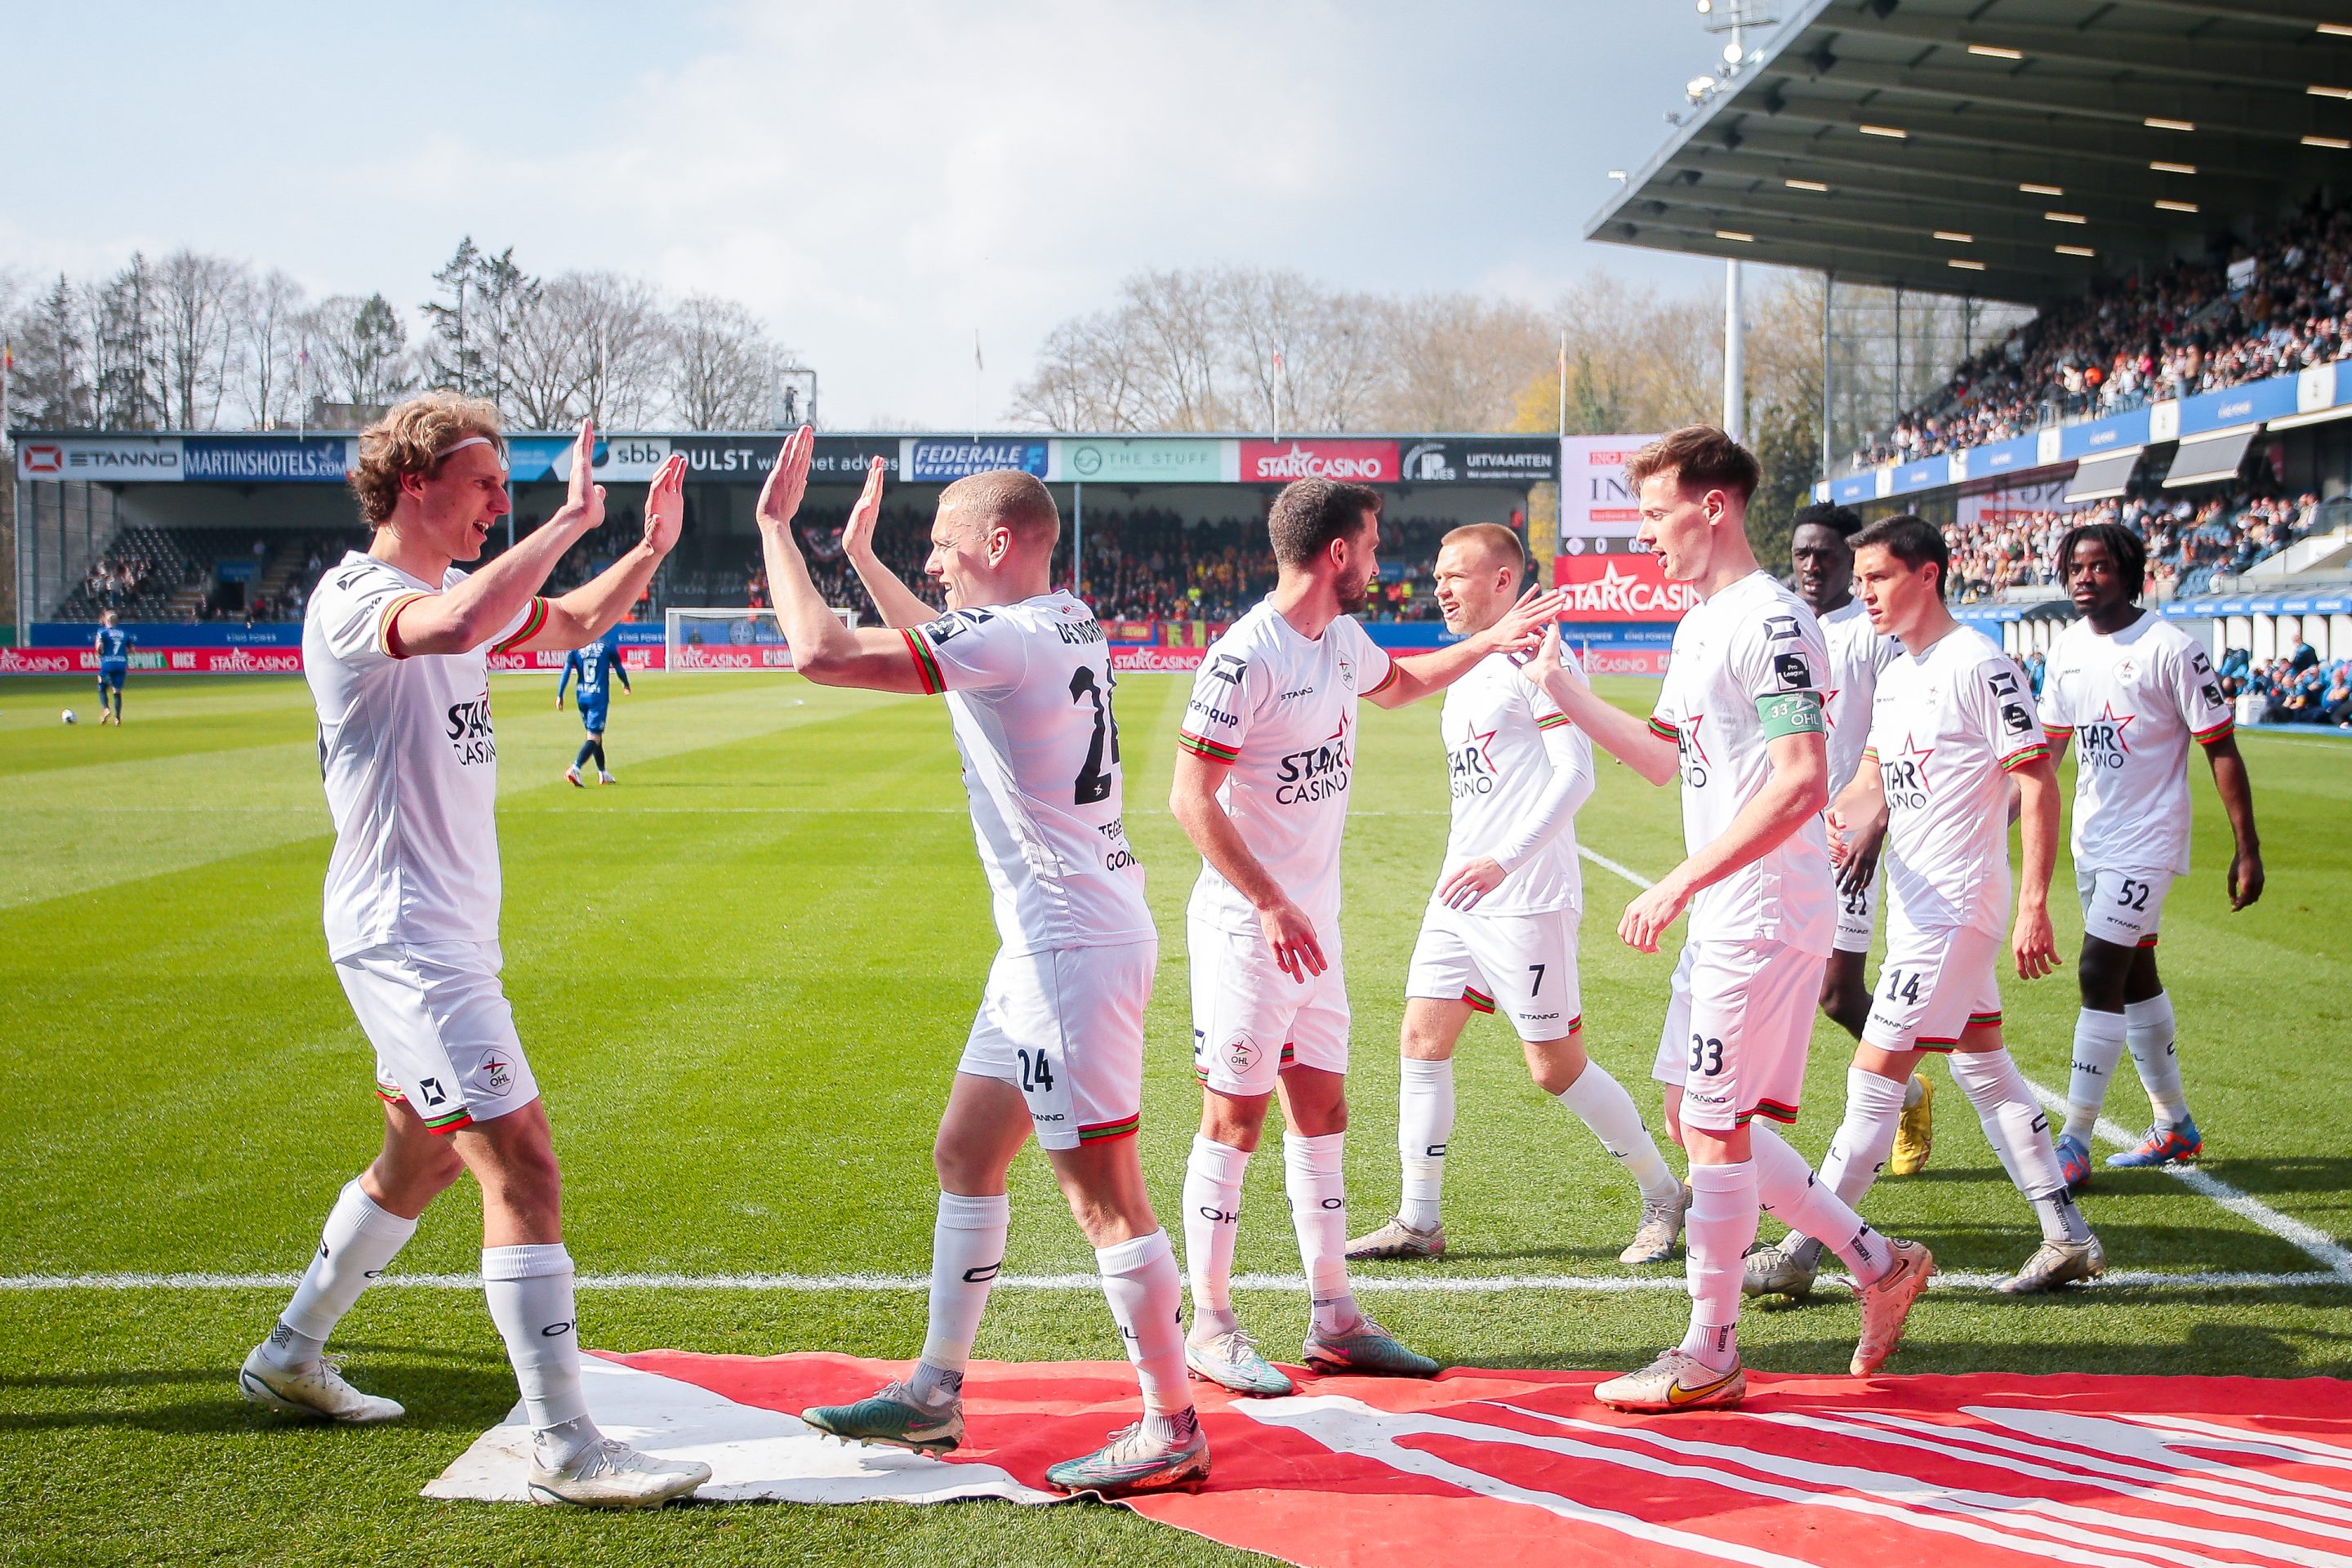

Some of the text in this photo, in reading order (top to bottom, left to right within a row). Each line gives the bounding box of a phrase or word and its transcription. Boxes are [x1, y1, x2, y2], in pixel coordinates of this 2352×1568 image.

[69, 450, 178, 468] STANNO
[617, 443, 661, 464] sbb
[840, 455, 899, 471] adves
[915, 444, 1022, 464] FEDERALE
[1109, 452, 1209, 465] THE STUFF
[1256, 449, 1382, 479] STARCASINO
[1466, 453, 1552, 467] UITVAARTEN
[1590, 478, 1630, 501] IN
[1558, 570, 1703, 615] STARCASIN
[641, 633, 665, 643] POWE
[1054, 621, 1080, 644] DE
[1071, 617, 1105, 644] NORR
[209, 652, 299, 672] STARCASINO
[537, 650, 572, 667] CASIN
[670, 650, 752, 669] TARCASINO
[1114, 651, 1202, 670] STARCASINO
[1771, 703, 1788, 719] 33
[1790, 713, 1820, 726] OHL
[2076, 724, 2118, 751] TAR
[453, 739, 497, 766] CASIN
[1276, 739, 1343, 782] STAR
[1448, 747, 1486, 777] TAR
[2081, 751, 2124, 769] ASINO
[1880, 760, 1919, 791] TAR
[1276, 770, 1348, 805] CASINO
[1451, 776, 1493, 799] SINO
[1098, 817, 1123, 841] TEGE
[1106, 849, 1140, 871] CON
[2117, 879, 2149, 912] 52
[2106, 916, 2140, 931] STANNO
[1528, 964, 1546, 998] 7
[1886, 969, 1921, 1006] 14
[1873, 1013, 1913, 1031] STANNO
[1231, 1055, 1249, 1066] OHL
[1689, 1033, 1723, 1076] 33
[489, 1072, 510, 1088] OHL
[1018, 1049, 1054, 1093] 24
[1032, 1112, 1065, 1122] TANNO
[1200, 1206, 1237, 1224] OH
[541, 1316, 577, 1338] OH
